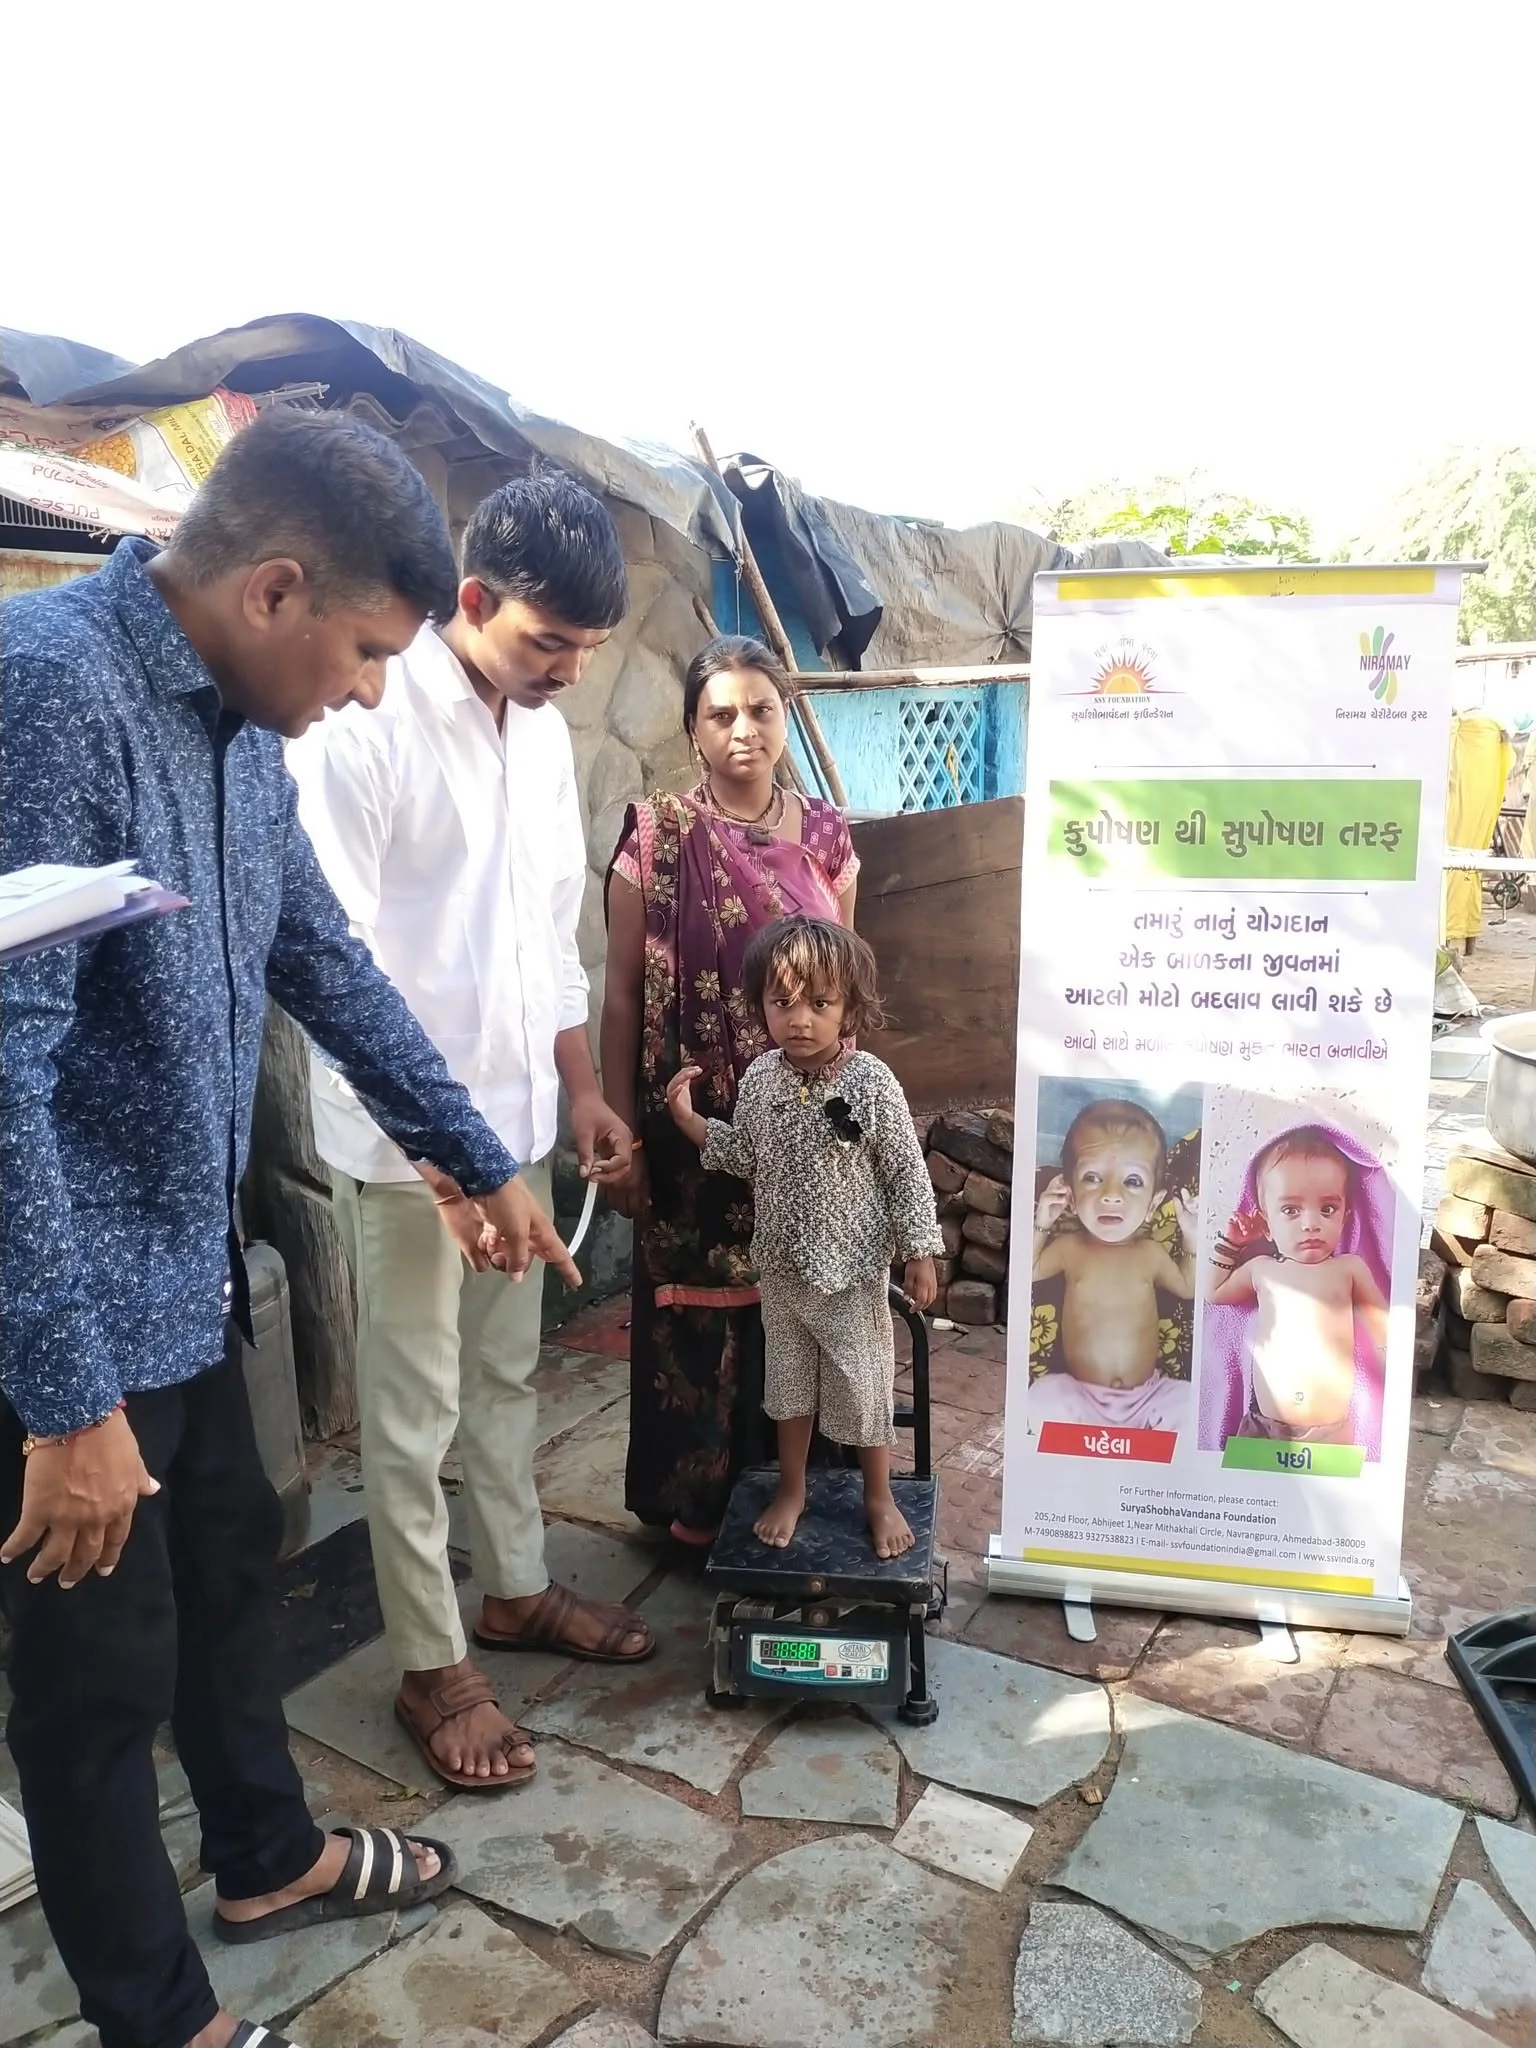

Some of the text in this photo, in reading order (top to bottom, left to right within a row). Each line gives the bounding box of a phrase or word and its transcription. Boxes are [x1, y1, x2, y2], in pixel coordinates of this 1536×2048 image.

[180, 432, 195, 455] DAL
[1360, 655, 1411, 670] NIRAMAY
[1335, 707, 1428, 722] નિરામય ચેરીટેબલ ટ્રસ્ટ
[1063, 809, 1403, 858] કુપોષણ થી સુપોષણ તરફ
[1134, 906, 1328, 940] તમારું નાનું યોગદાન
[1119, 943, 1340, 978] એક બાળકના જીવનમાં
[1064, 981, 1393, 1014] આટલો મોટો બદલાવ લાવી શકે છે
[1064, 1029, 1096, 1050] આવો
[1102, 1030, 1129, 1051] સાથે
[1284, 1043, 1321, 1058] ભારત
[1327, 1038, 1388, 1060] બનાવીએ
[1083, 1430, 1132, 1455] પહેલા
[1276, 1447, 1312, 1470] પછી
[1119, 1485, 1279, 1507] For Further Information, please contact:
[1120, 1502, 1277, 1525] SuryaShobhaVandana Foundation
[1034, 1511, 1366, 1549] 205,2nd Floor, Abhijeet 1,Near Mithakhali Circle, Navrangpura, Ahmedabad-380009
[1024, 1526, 1084, 1540] M-7490898823
[1085, 1532, 1134, 1545] 9327538823
[1170, 1540, 1296, 1560] ssvfoundationindia@gmail.com
[1303, 1553, 1376, 1568] www.ssvindia.org
